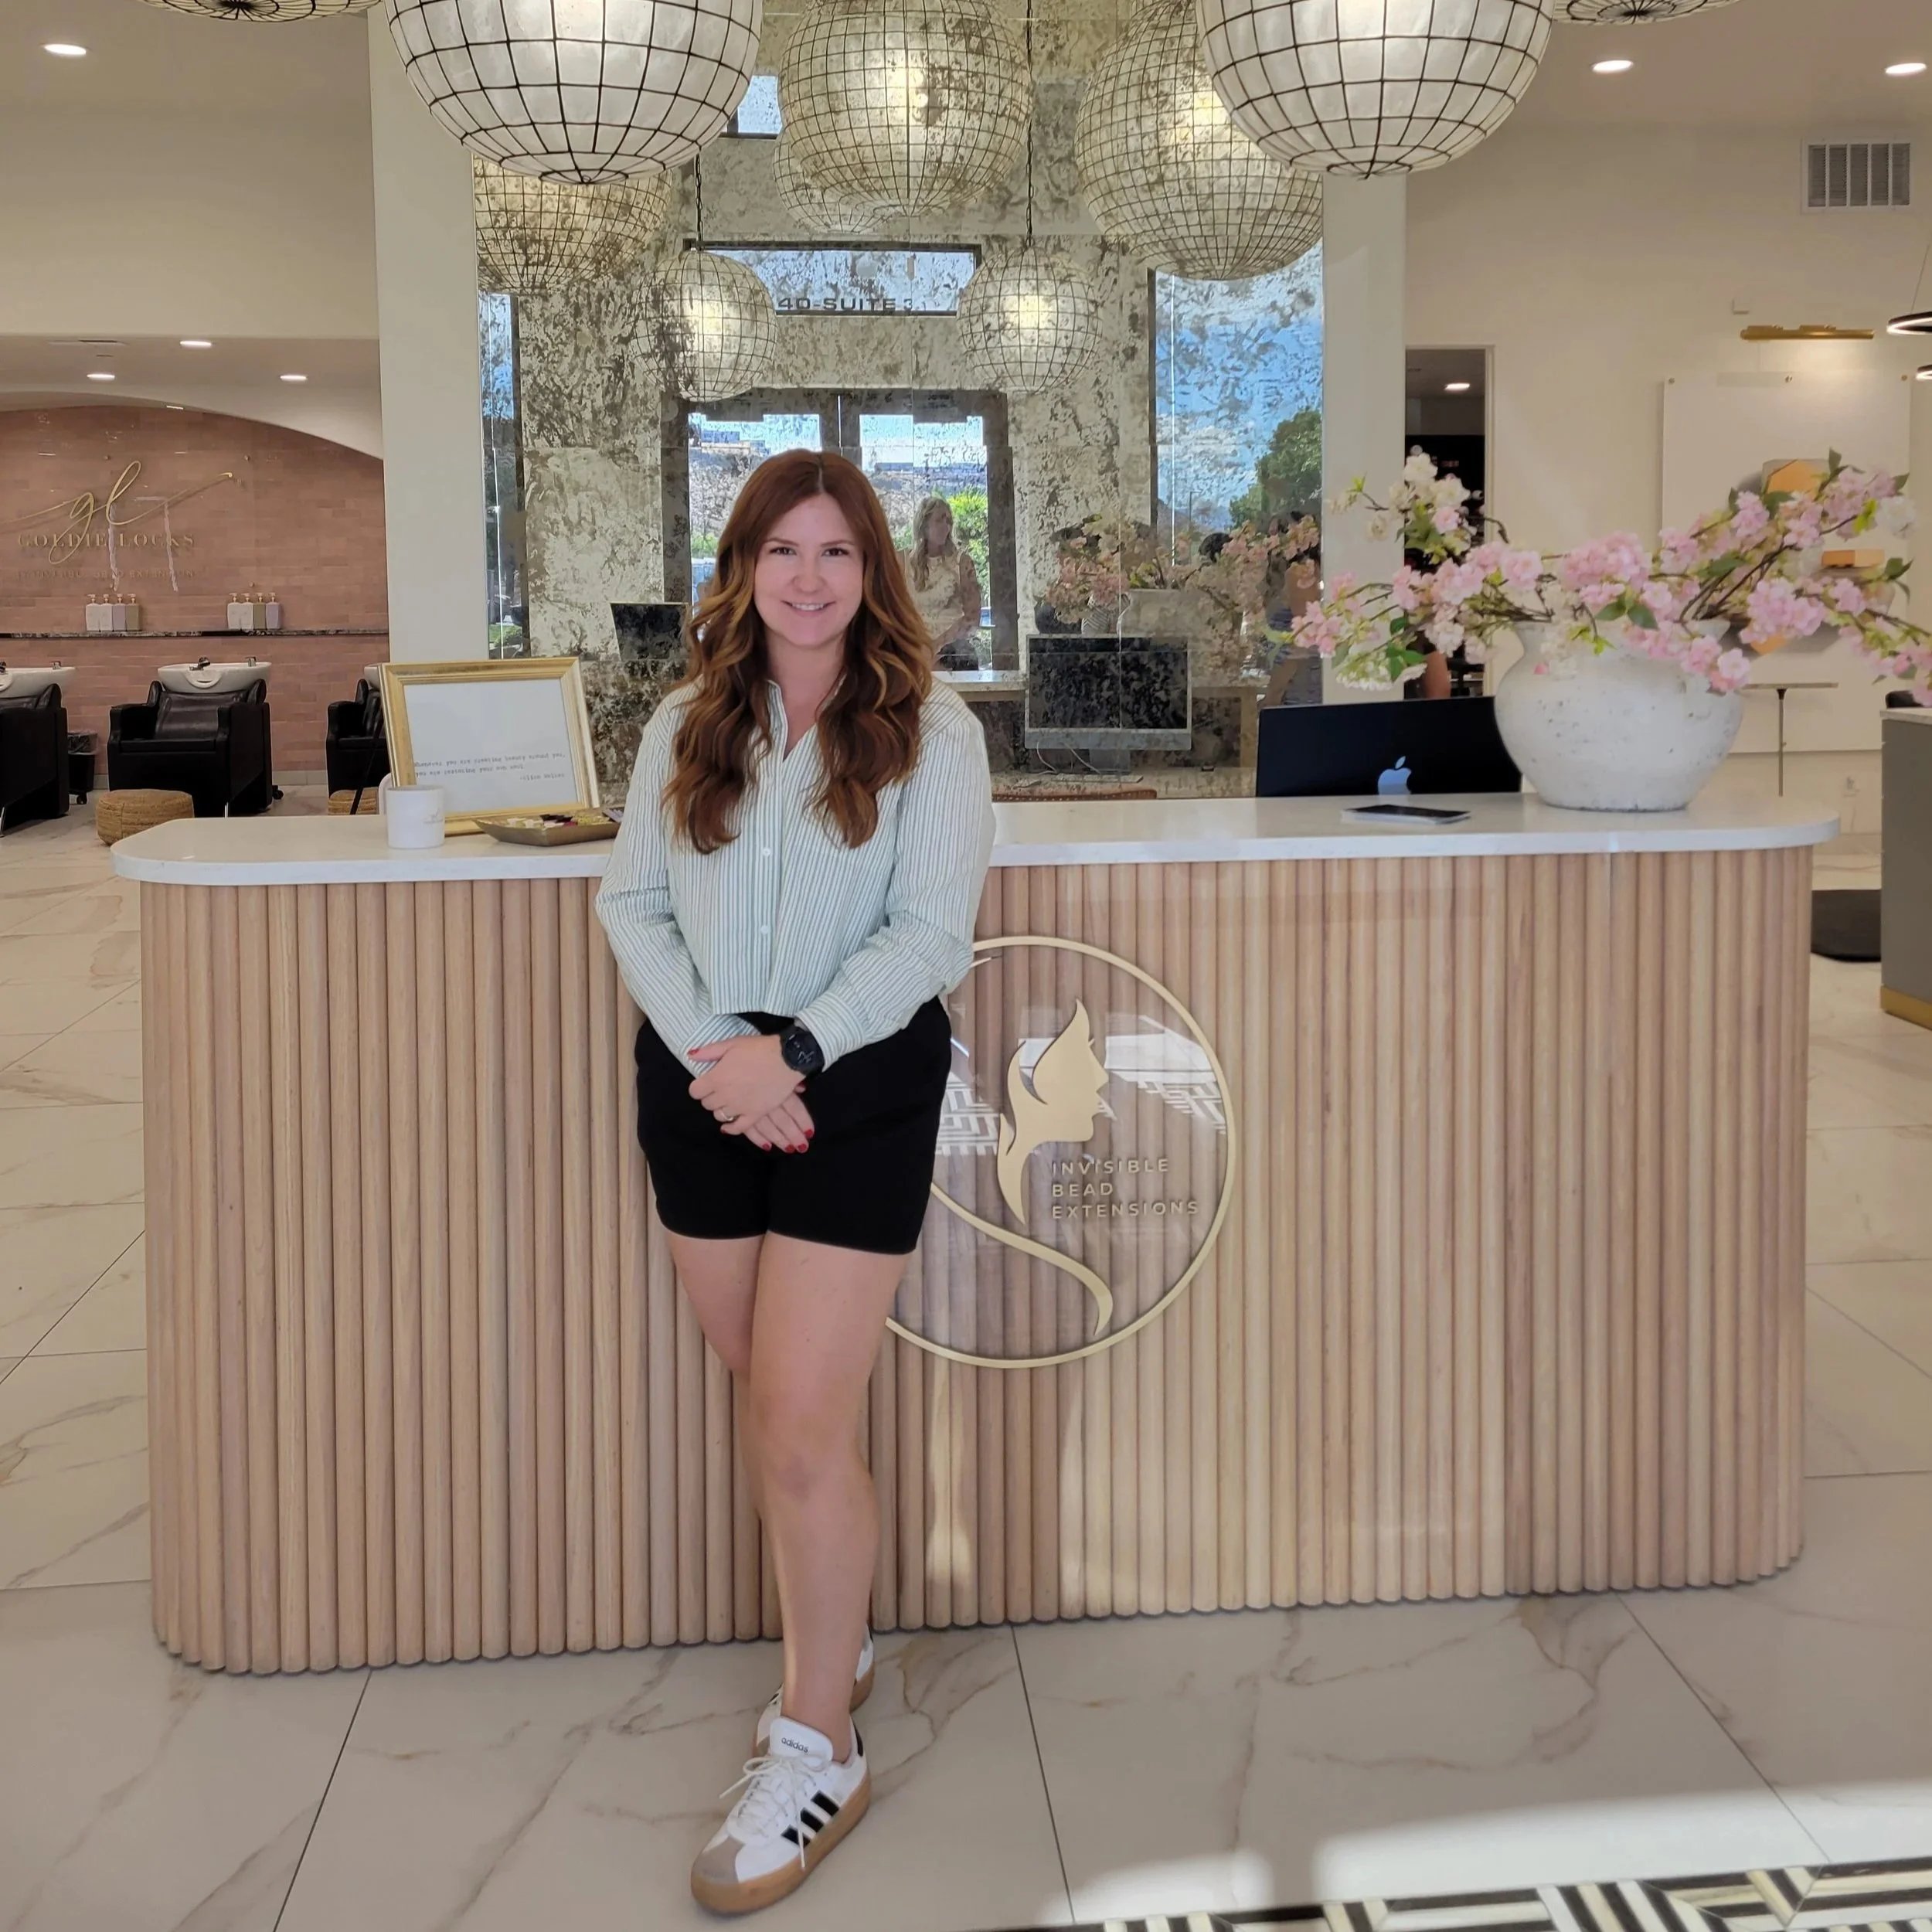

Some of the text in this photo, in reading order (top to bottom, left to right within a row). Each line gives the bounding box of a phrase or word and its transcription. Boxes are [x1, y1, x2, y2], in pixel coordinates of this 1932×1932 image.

[18, 533, 194, 547] GOLDIE LOCKS
[1053, 1158, 1169, 1176] INVISIBLE
[1053, 1182, 1114, 1198] BEAD
[1052, 1201, 1198, 1219] EXTENSIONS
[781, 1736, 809, 1753] adidas
